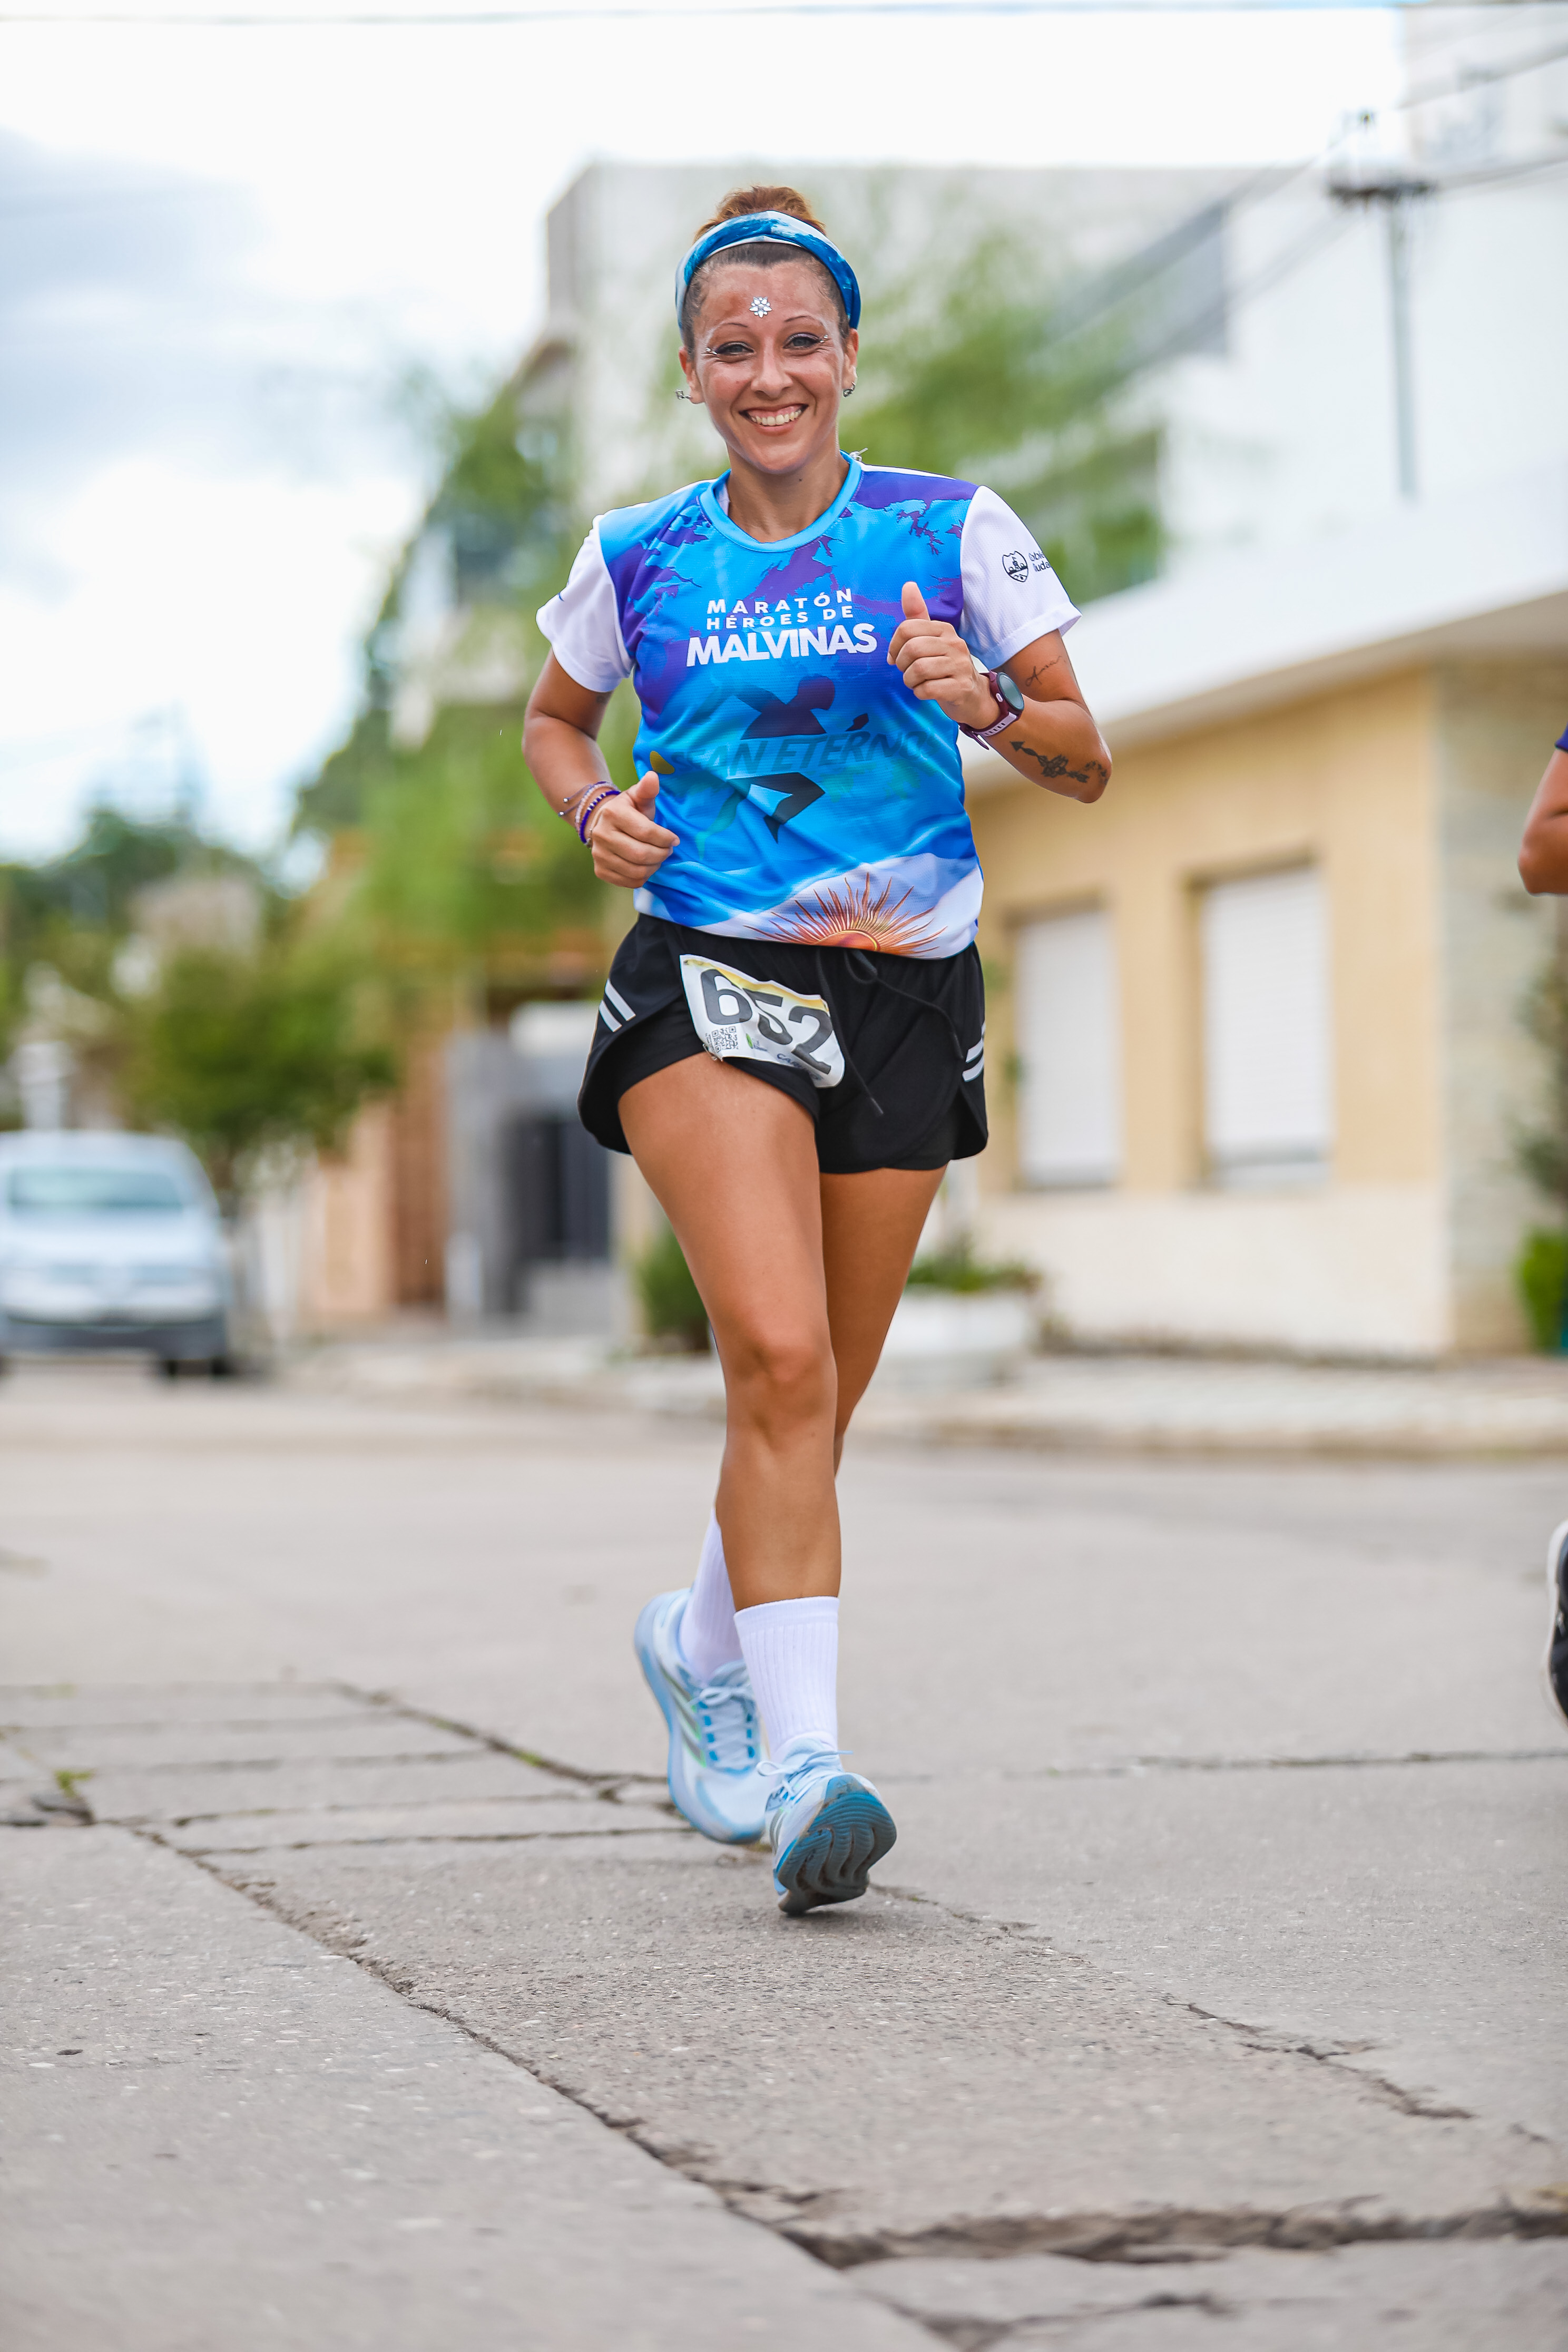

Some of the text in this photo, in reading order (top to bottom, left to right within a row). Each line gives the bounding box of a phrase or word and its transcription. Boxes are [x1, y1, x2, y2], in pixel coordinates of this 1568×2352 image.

[707, 588, 852, 614] MARATÓN
[707, 605, 854, 630] HÉROES DE
[686, 623, 878, 667] MALVINAS
[700, 968, 833, 1075] 652
